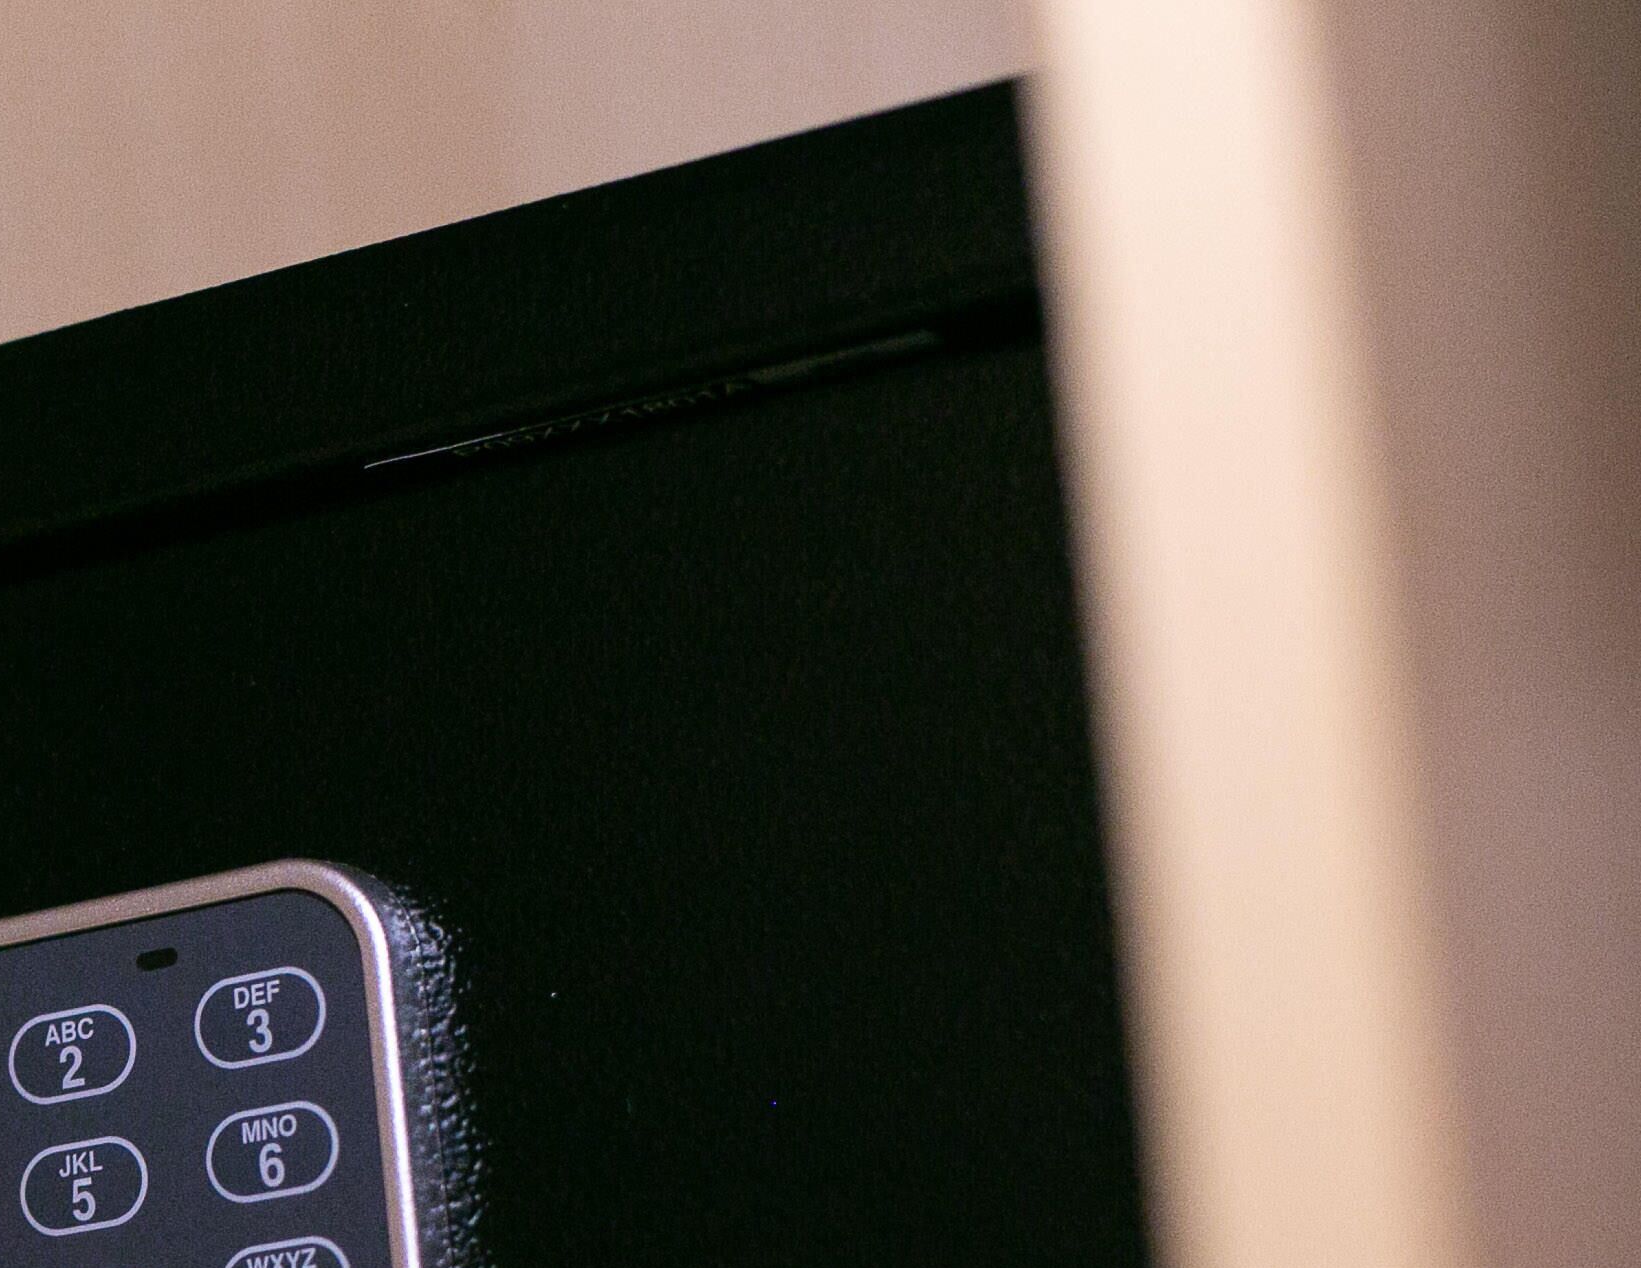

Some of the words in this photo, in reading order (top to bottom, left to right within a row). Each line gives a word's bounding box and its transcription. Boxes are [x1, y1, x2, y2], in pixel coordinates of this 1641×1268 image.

[233, 980, 280, 1009] DEF
[44, 1017, 94, 1046] ABC
[247, 1009, 272, 1052] 3
[60, 1046, 85, 1089] 2
[241, 1113, 297, 1143] MNO
[58, 1151, 103, 1179] JKL
[260, 1143, 286, 1189] 6
[73, 1177, 97, 1223] 5
